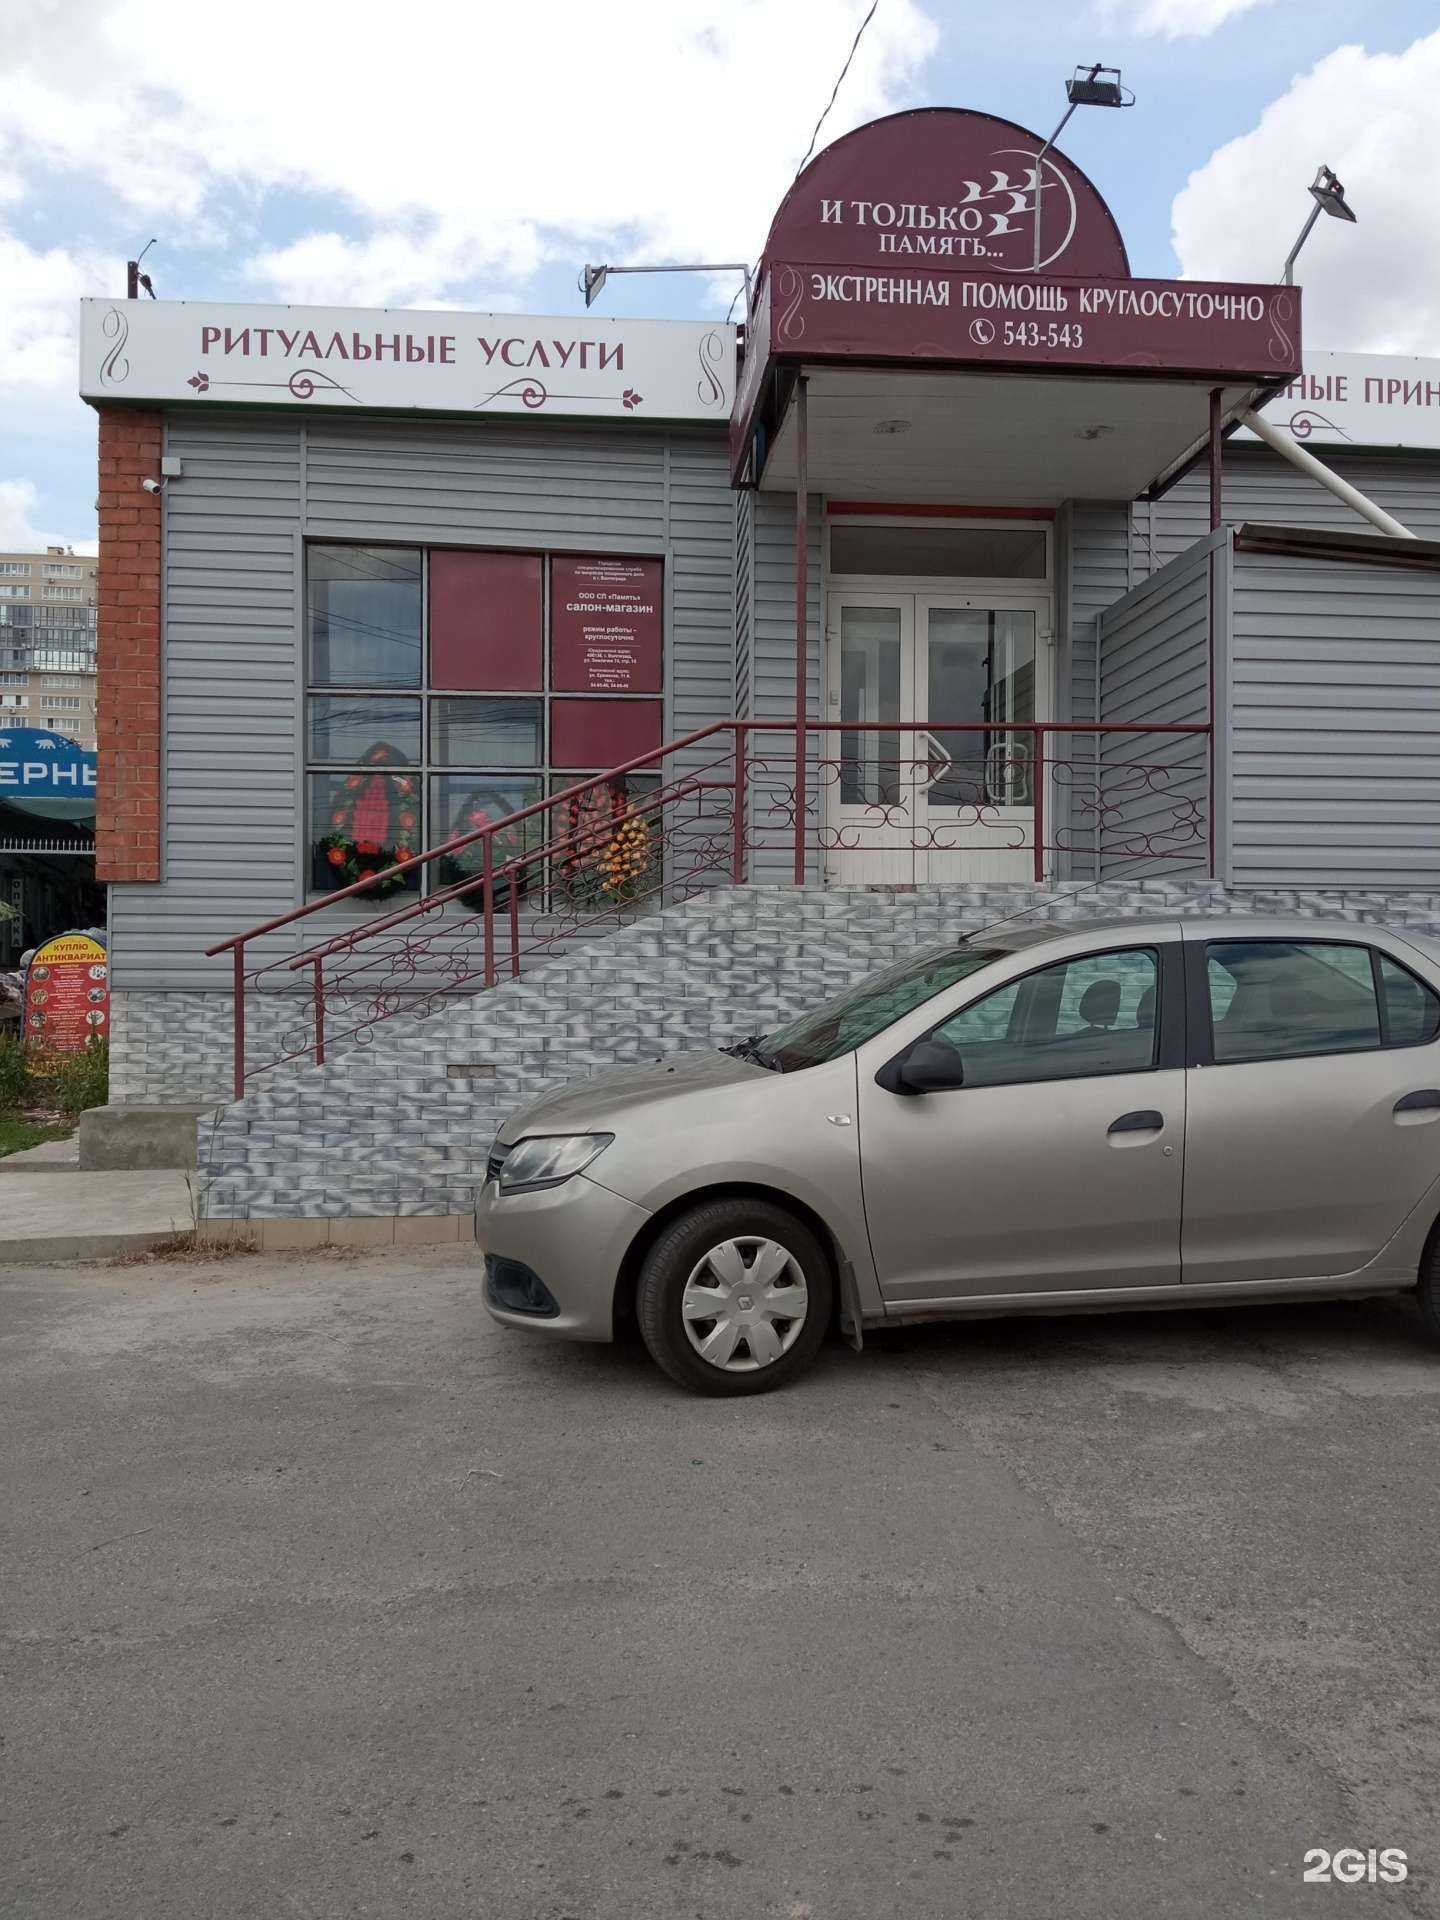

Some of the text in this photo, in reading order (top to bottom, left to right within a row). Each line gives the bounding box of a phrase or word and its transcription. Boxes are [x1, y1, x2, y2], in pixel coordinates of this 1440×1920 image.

[820, 199, 983, 232] И ТОЛЬКО
[879, 233, 1004, 257] ПАМЯТЬ...
[811, 273, 1265, 321] ЭКСТРЕННАЯ ПОМОЩЬ КРУГЛОСУТОЧНО
[1003, 320, 1084, 349] 543-543
[201, 326, 624, 370] РИТУАЛЬНЫЕ УСЛУГИ
[566, 602, 653, 614] салон-магазин
[35, 952, 107, 963] АНТИКВАРИАТ
[53, 942, 89, 952] КУПЛЮ
